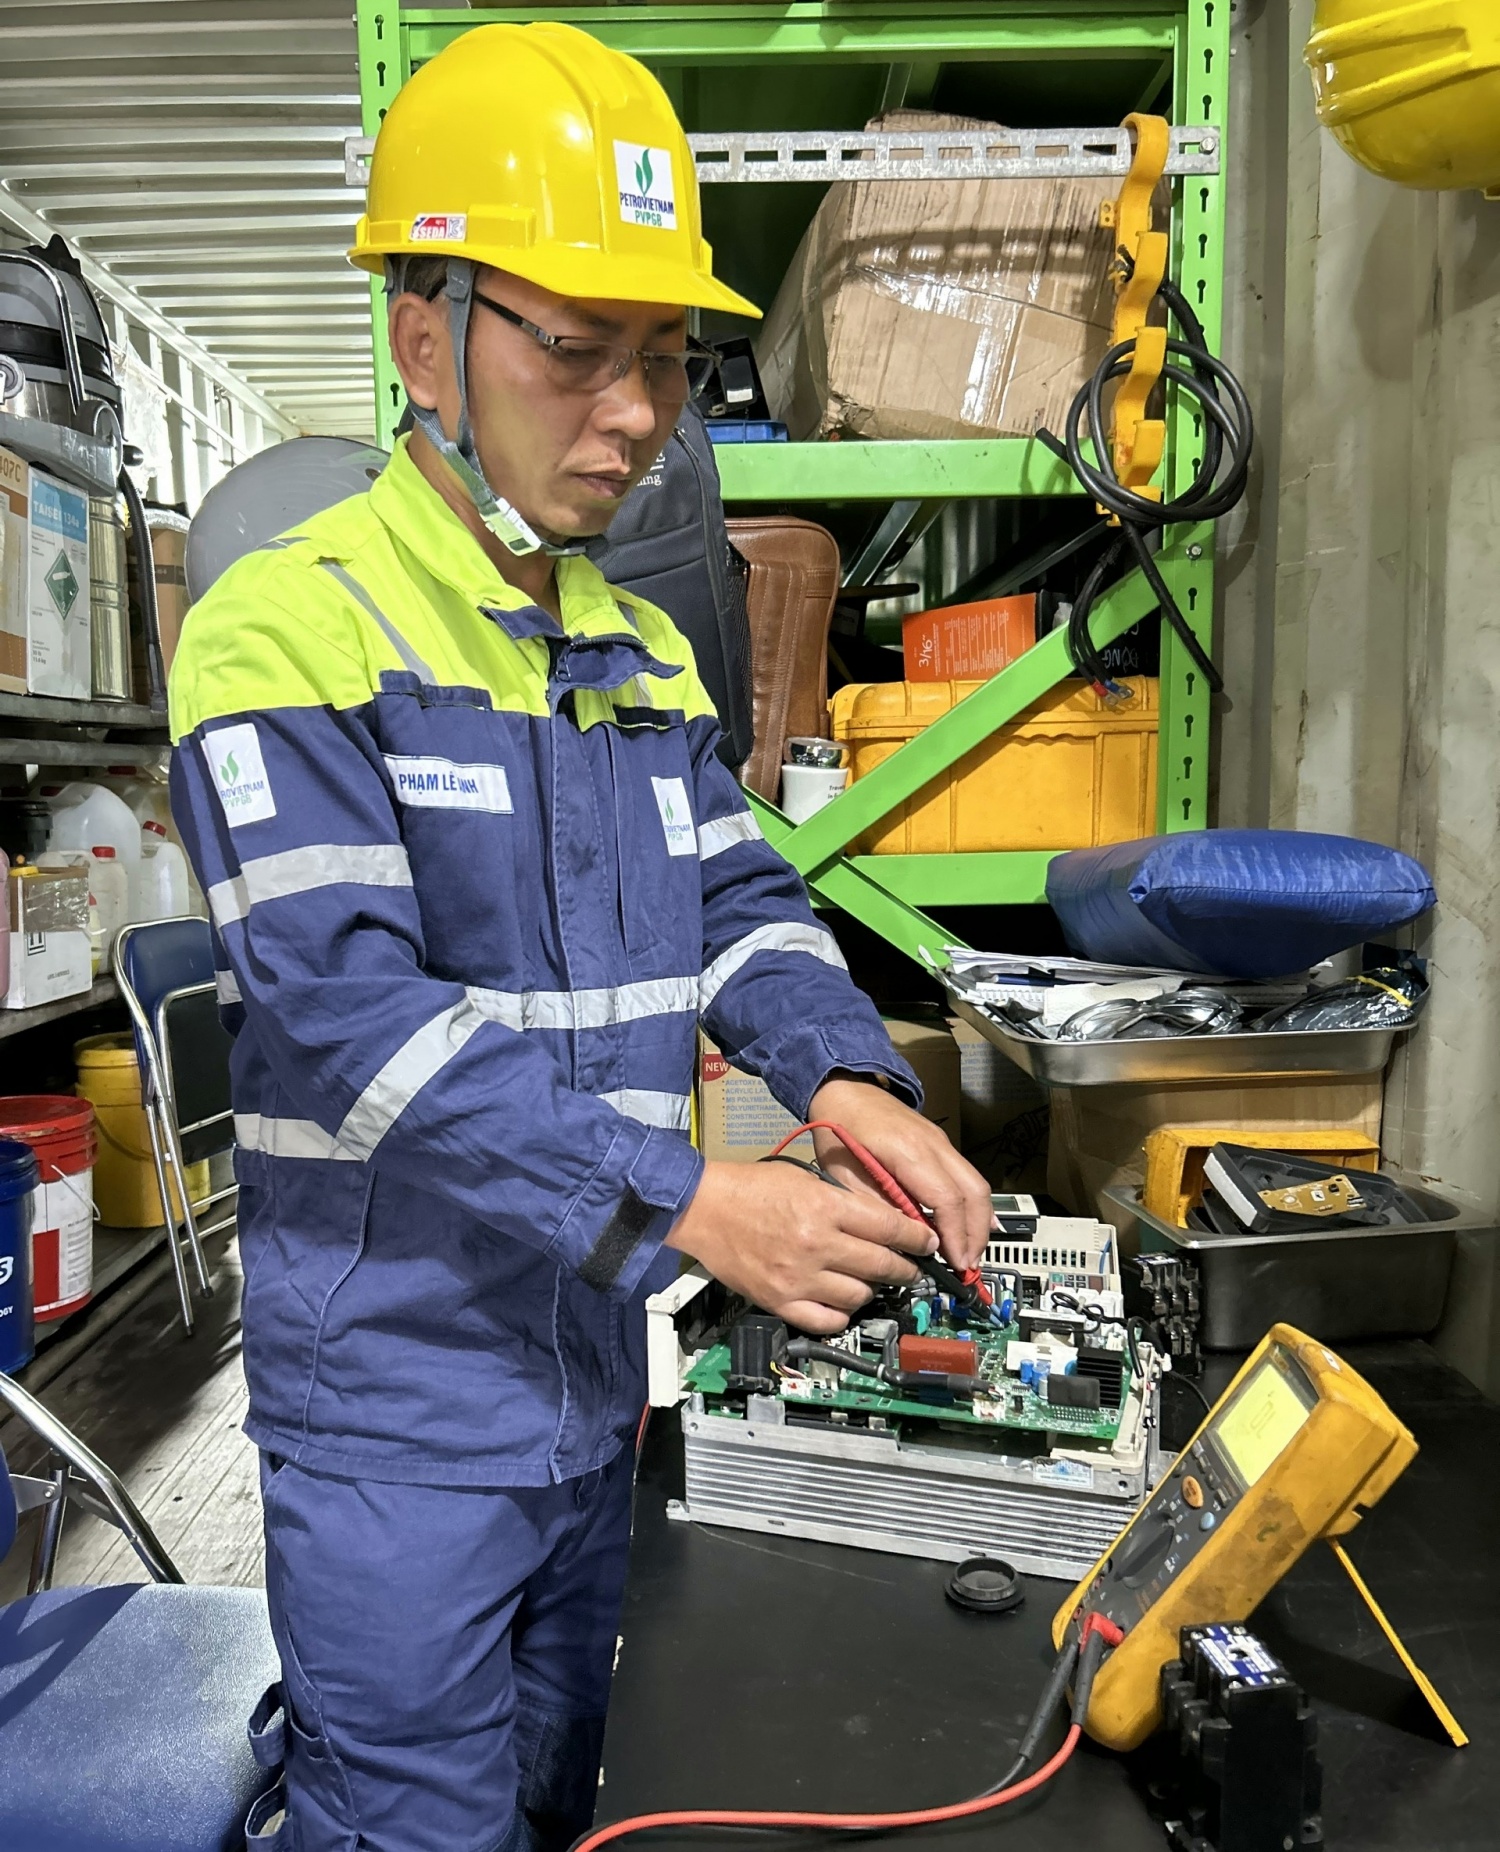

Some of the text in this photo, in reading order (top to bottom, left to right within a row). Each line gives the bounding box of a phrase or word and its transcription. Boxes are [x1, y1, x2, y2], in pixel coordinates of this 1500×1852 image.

[619, 191, 675, 215] PETROVIETNAM
[0, 455, 21, 483] 07C
[637, 474, 662, 486] ing
[33, 501, 62, 521] TAISEI
[398, 773, 439, 795] PHẠM
[442, 770, 457, 791] LÊ
[705, 1061, 729, 1072] NEW
[726, 1121, 763, 1129] NEOPRENE
[727, 1138, 752, 1146] AWNING
